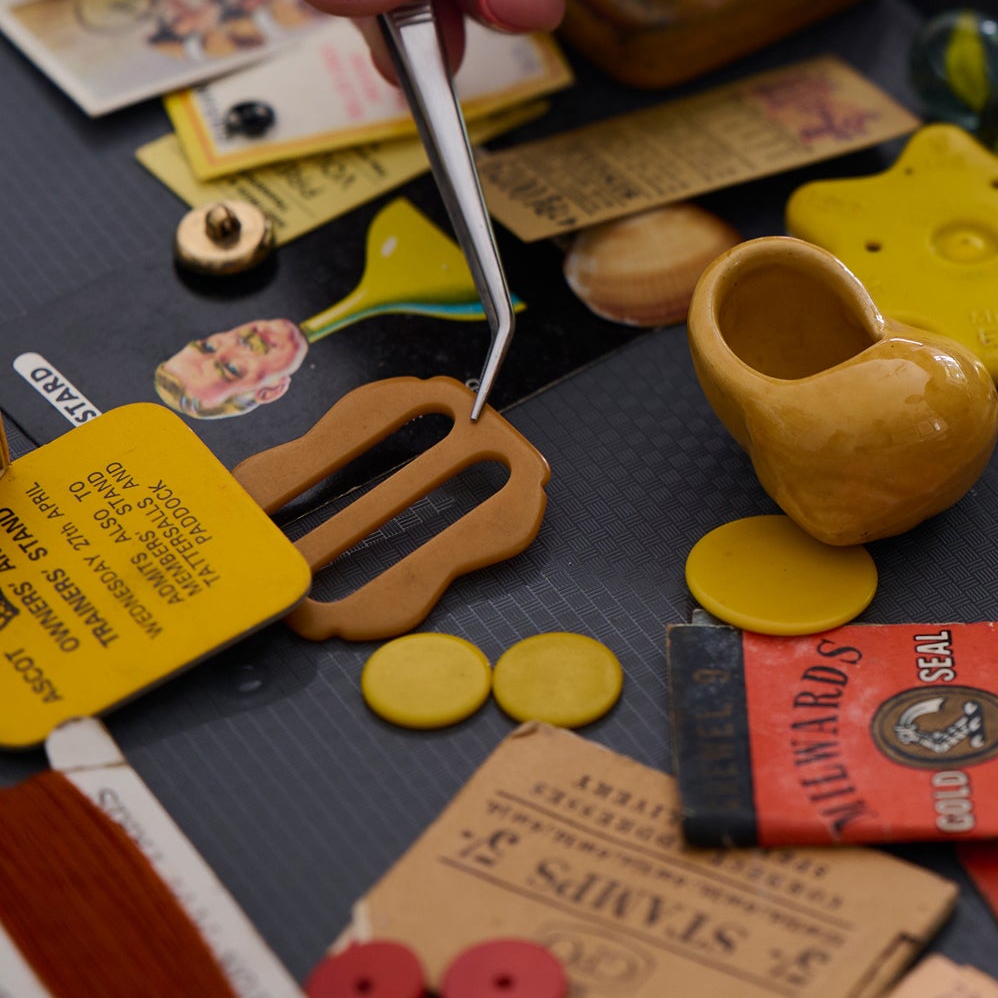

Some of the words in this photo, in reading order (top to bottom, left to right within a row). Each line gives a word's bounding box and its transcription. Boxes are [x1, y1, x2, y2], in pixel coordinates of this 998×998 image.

[25, 481, 65, 519] APRIL
[68, 481, 92, 503] TO
[87, 471, 133, 516] STAND
[105, 461, 140, 490] AND
[0, 507, 48, 561] STAND
[60, 521, 91, 551] 27th
[93, 508, 133, 544] ALSO
[136, 496, 219, 587] TATTERSALLS
[148, 479, 212, 546] PADDOCK
[130, 551, 185, 605] ADMITS
[135, 530, 199, 597] MEMBERS'
[7, 581, 80, 652] OWNERS'
[41, 568, 118, 648] TRAINERS'
[83, 554, 163, 639] WEDNESDAY
[3, 647, 63, 703] ASCOT
[917, 628, 954, 683] SEAL
[793, 638, 868, 840] MILWARDS
[533, 783, 677, 851] DDRESSES
[932, 769, 977, 833] GOLD
[534, 859, 742, 955] STAMPS
